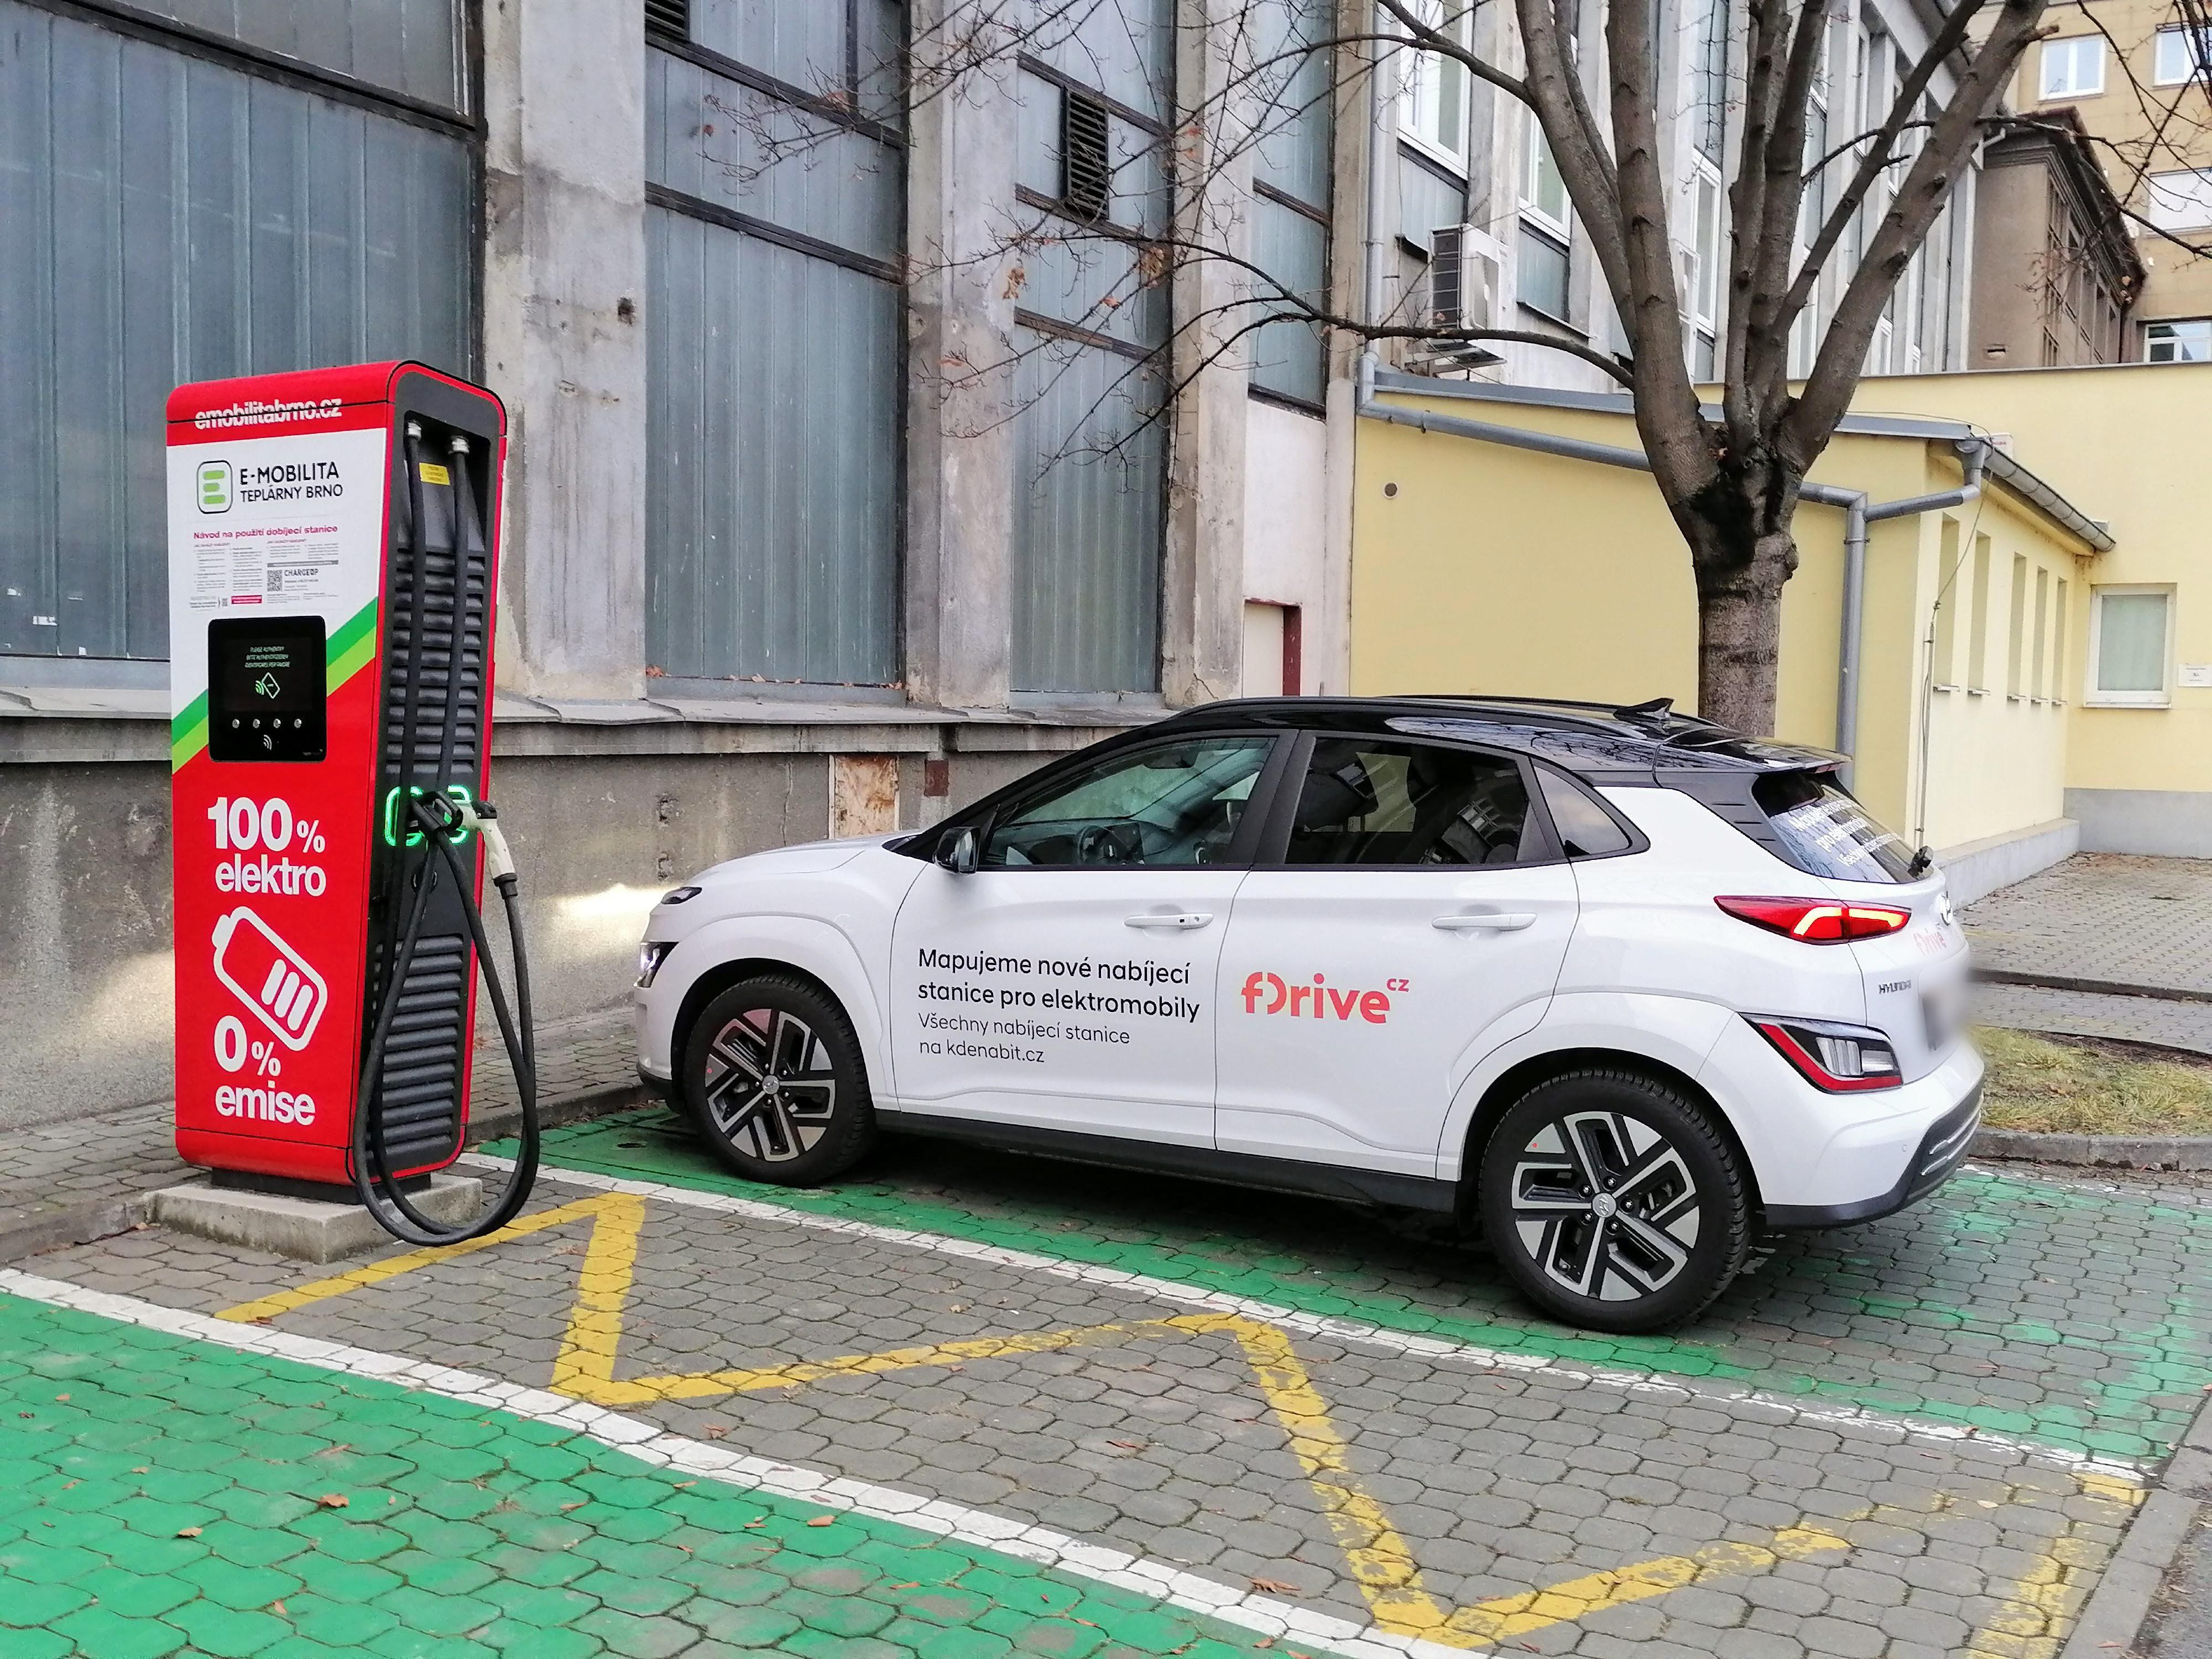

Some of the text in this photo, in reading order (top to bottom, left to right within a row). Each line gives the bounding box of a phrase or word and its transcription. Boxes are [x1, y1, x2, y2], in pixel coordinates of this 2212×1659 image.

[194, 398, 342, 430] emobilitabrno.cz
[240, 461, 339, 485] E-MOBILITA
[240, 484, 343, 503] TEPLÁRNY BRNO
[194, 531, 220, 539] Návod
[304, 525, 338, 534] stanice
[215, 854, 326, 897] elektro
[919, 948, 1191, 987] Mapujeme nové nabíjecí
[918, 982, 1201, 1023] stanice pro elektromobily
[918, 1012, 1130, 1044] Všechny nabíjecí stanice
[920, 1039, 1045, 1063] na kdenabit.cz
[215, 1081, 316, 1126] emise
